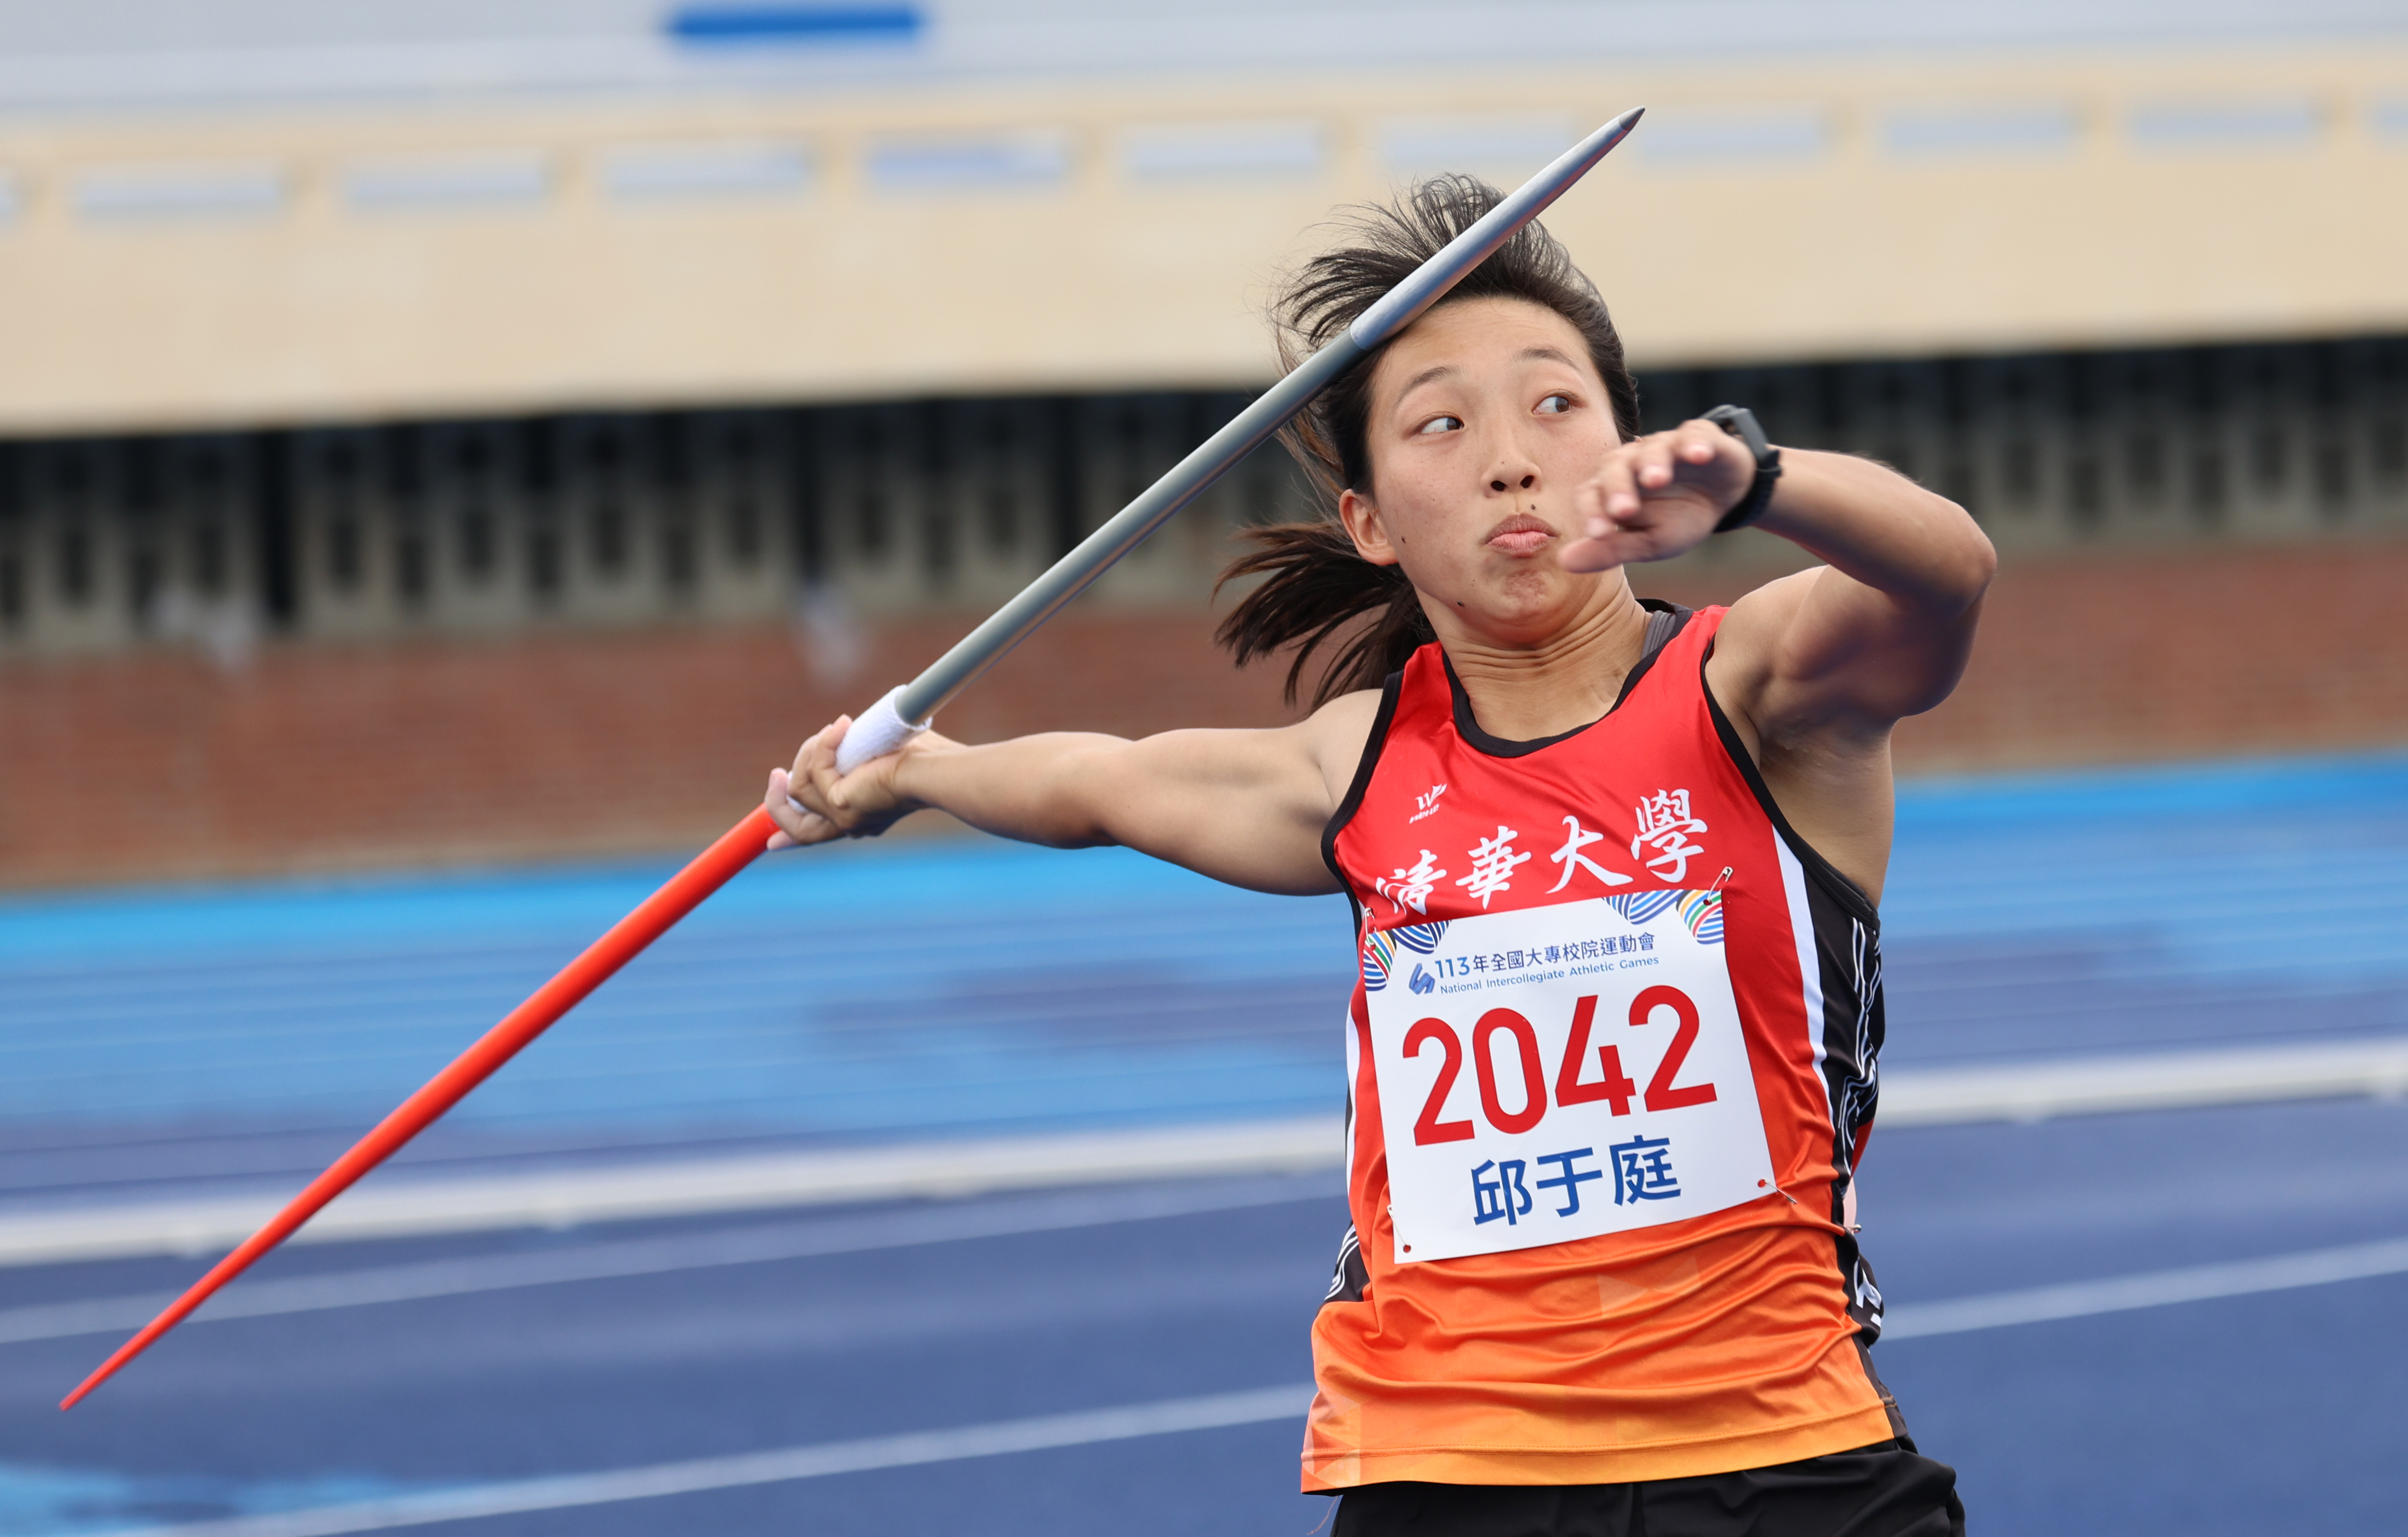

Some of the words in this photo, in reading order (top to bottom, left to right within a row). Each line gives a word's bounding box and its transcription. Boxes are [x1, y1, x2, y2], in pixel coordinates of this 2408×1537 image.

[1375, 788, 1708, 915] 清華大學
[1435, 932, 1655, 978] 113年全國大專校院運動會
[1440, 980, 1482, 994] National
[1486, 970, 1564, 988] Intercollegiate
[1569, 961, 1614, 977] Athletic
[1620, 957, 1659, 969] Games
[1402, 985, 1718, 1147] 2042
[1471, 1135, 1681, 1226] 邱于庭
